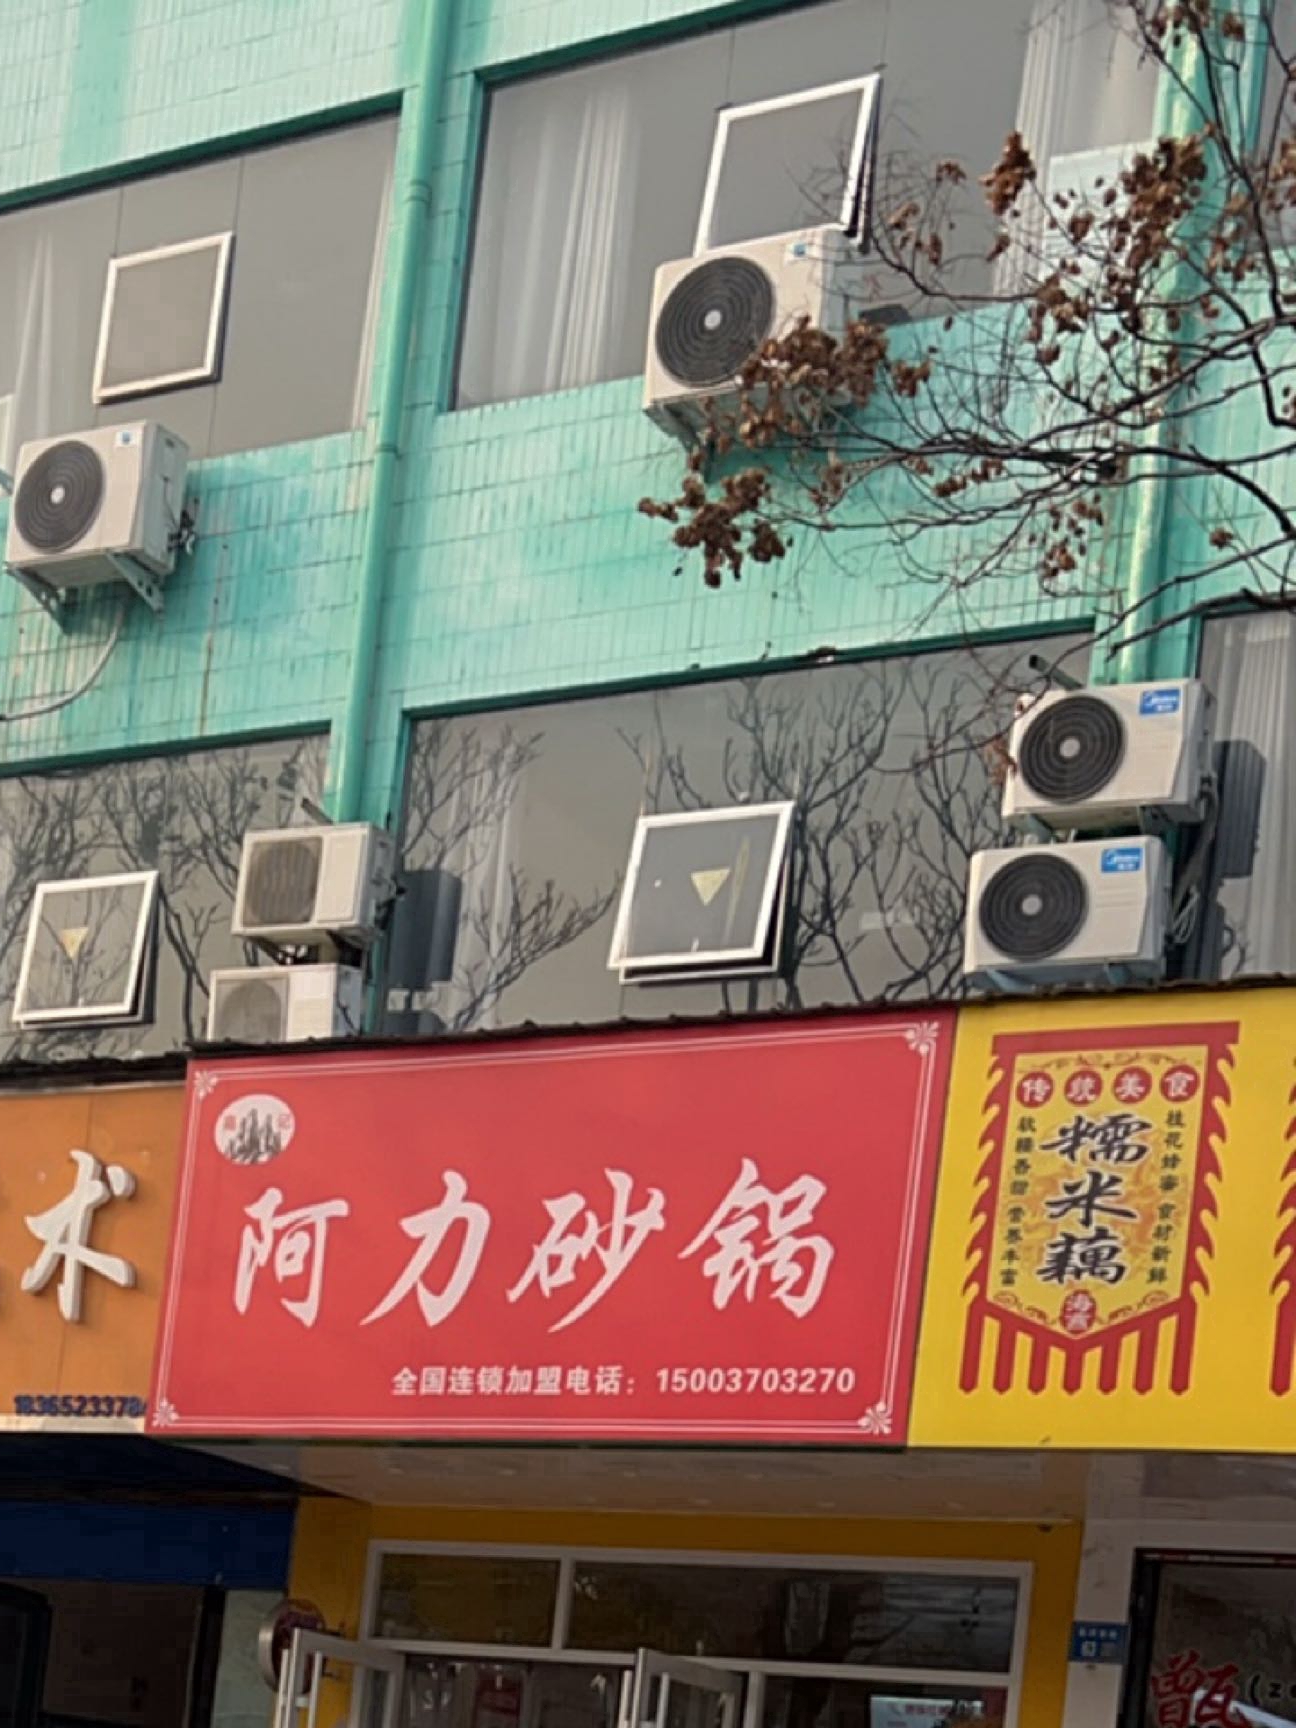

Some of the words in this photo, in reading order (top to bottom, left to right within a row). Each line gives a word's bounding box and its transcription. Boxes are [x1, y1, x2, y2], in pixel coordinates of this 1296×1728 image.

[232, 1157, 837, 1333] 阿力砂锅
[1038, 1112, 1153, 1285] 糯米藕
[14, 1395, 147, 1418] 1836523378
[656, 1365, 856, 1394] 15003703270
